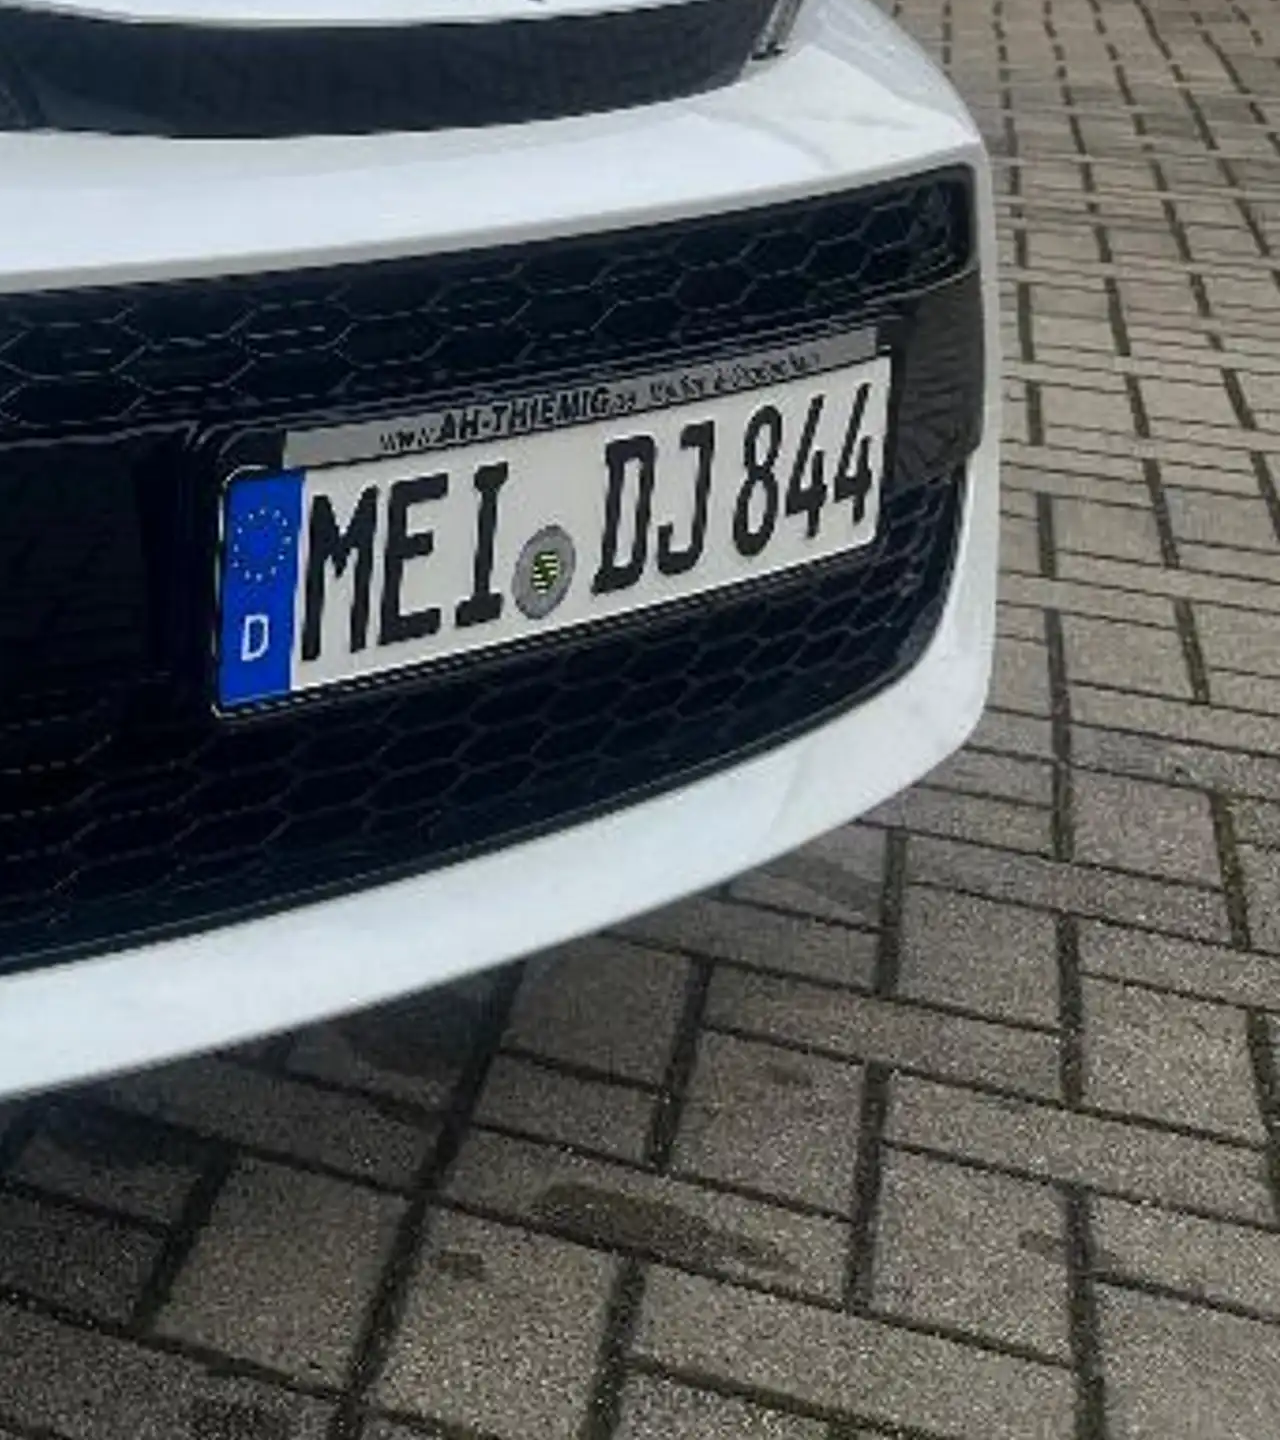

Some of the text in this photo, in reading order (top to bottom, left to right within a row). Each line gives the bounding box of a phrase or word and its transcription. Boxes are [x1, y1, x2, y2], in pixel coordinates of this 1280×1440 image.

[301, 382, 872, 661] MEI DJ 844
[241, 613, 270, 662] D
